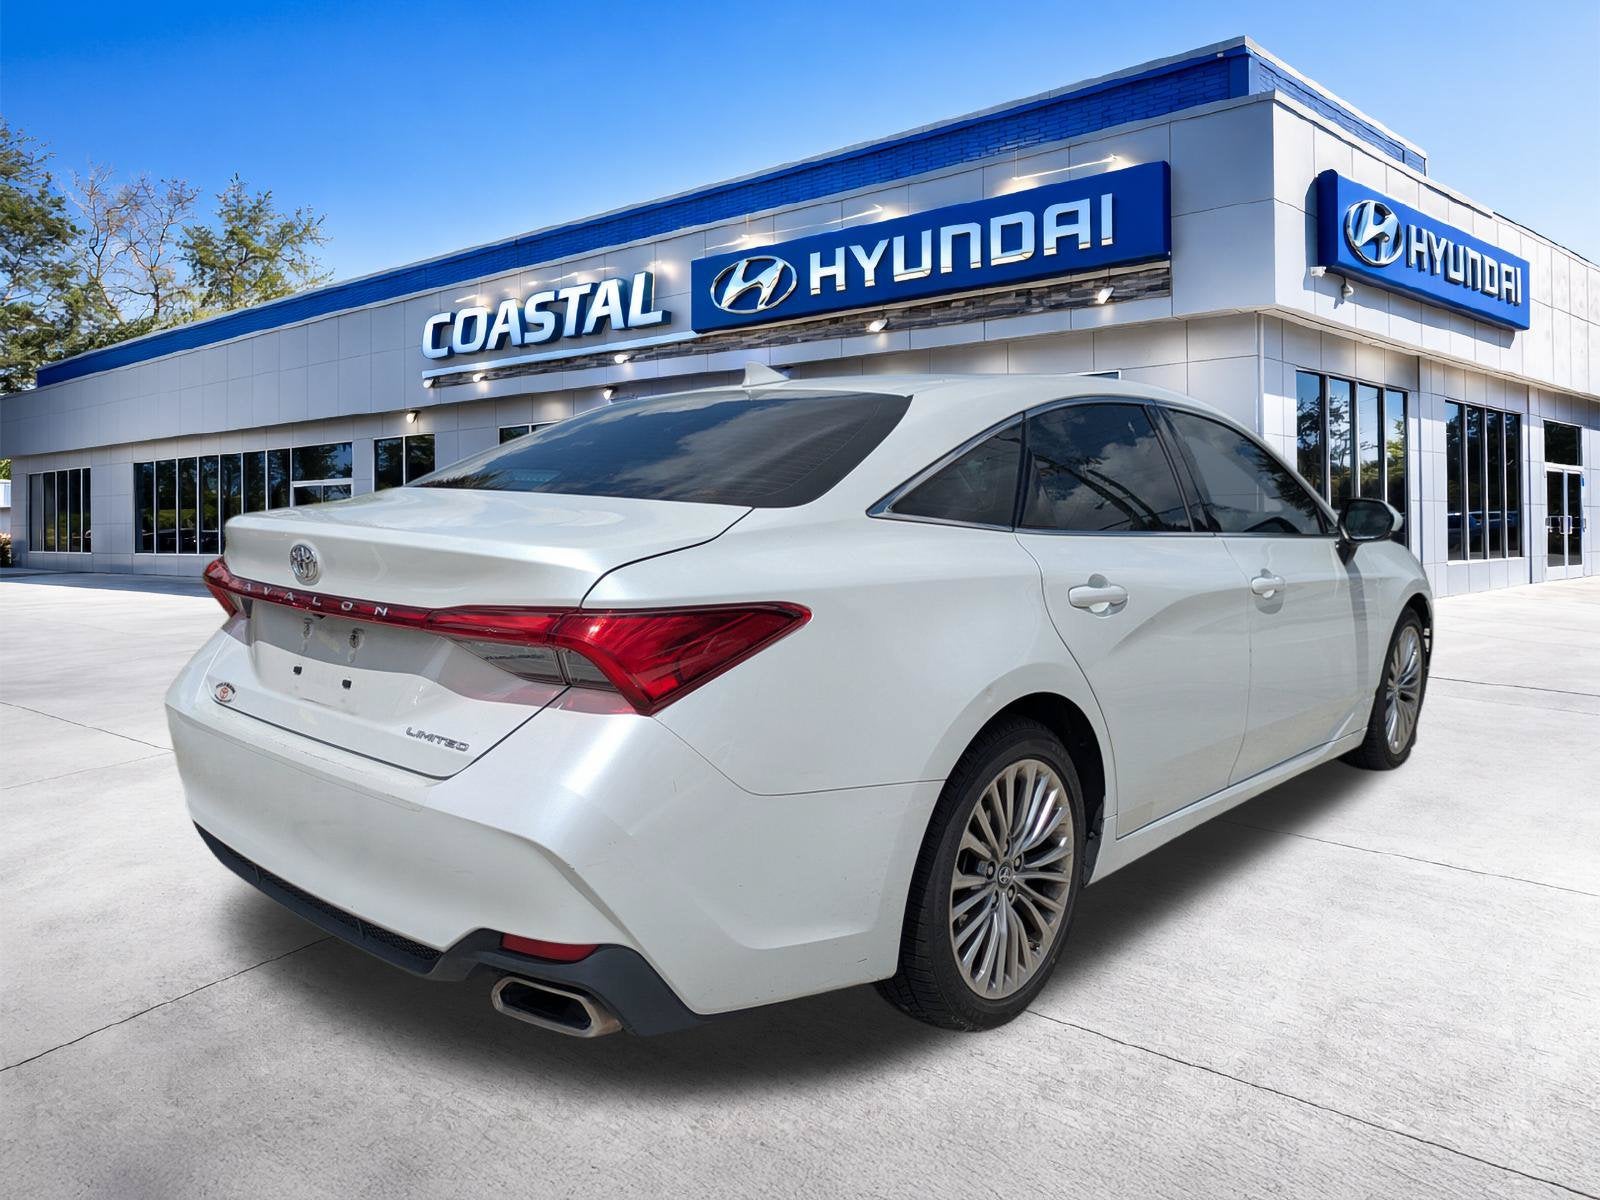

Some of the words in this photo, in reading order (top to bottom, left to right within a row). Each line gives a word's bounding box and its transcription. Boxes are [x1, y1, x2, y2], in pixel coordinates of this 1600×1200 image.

[809, 193, 1114, 296] HYUNDAI
[1407, 224, 1522, 306] HYUNDAI
[422, 271, 667, 359] COASTAL
[243, 582, 389, 617] AVALON
[406, 726, 470, 752] LIMITED
